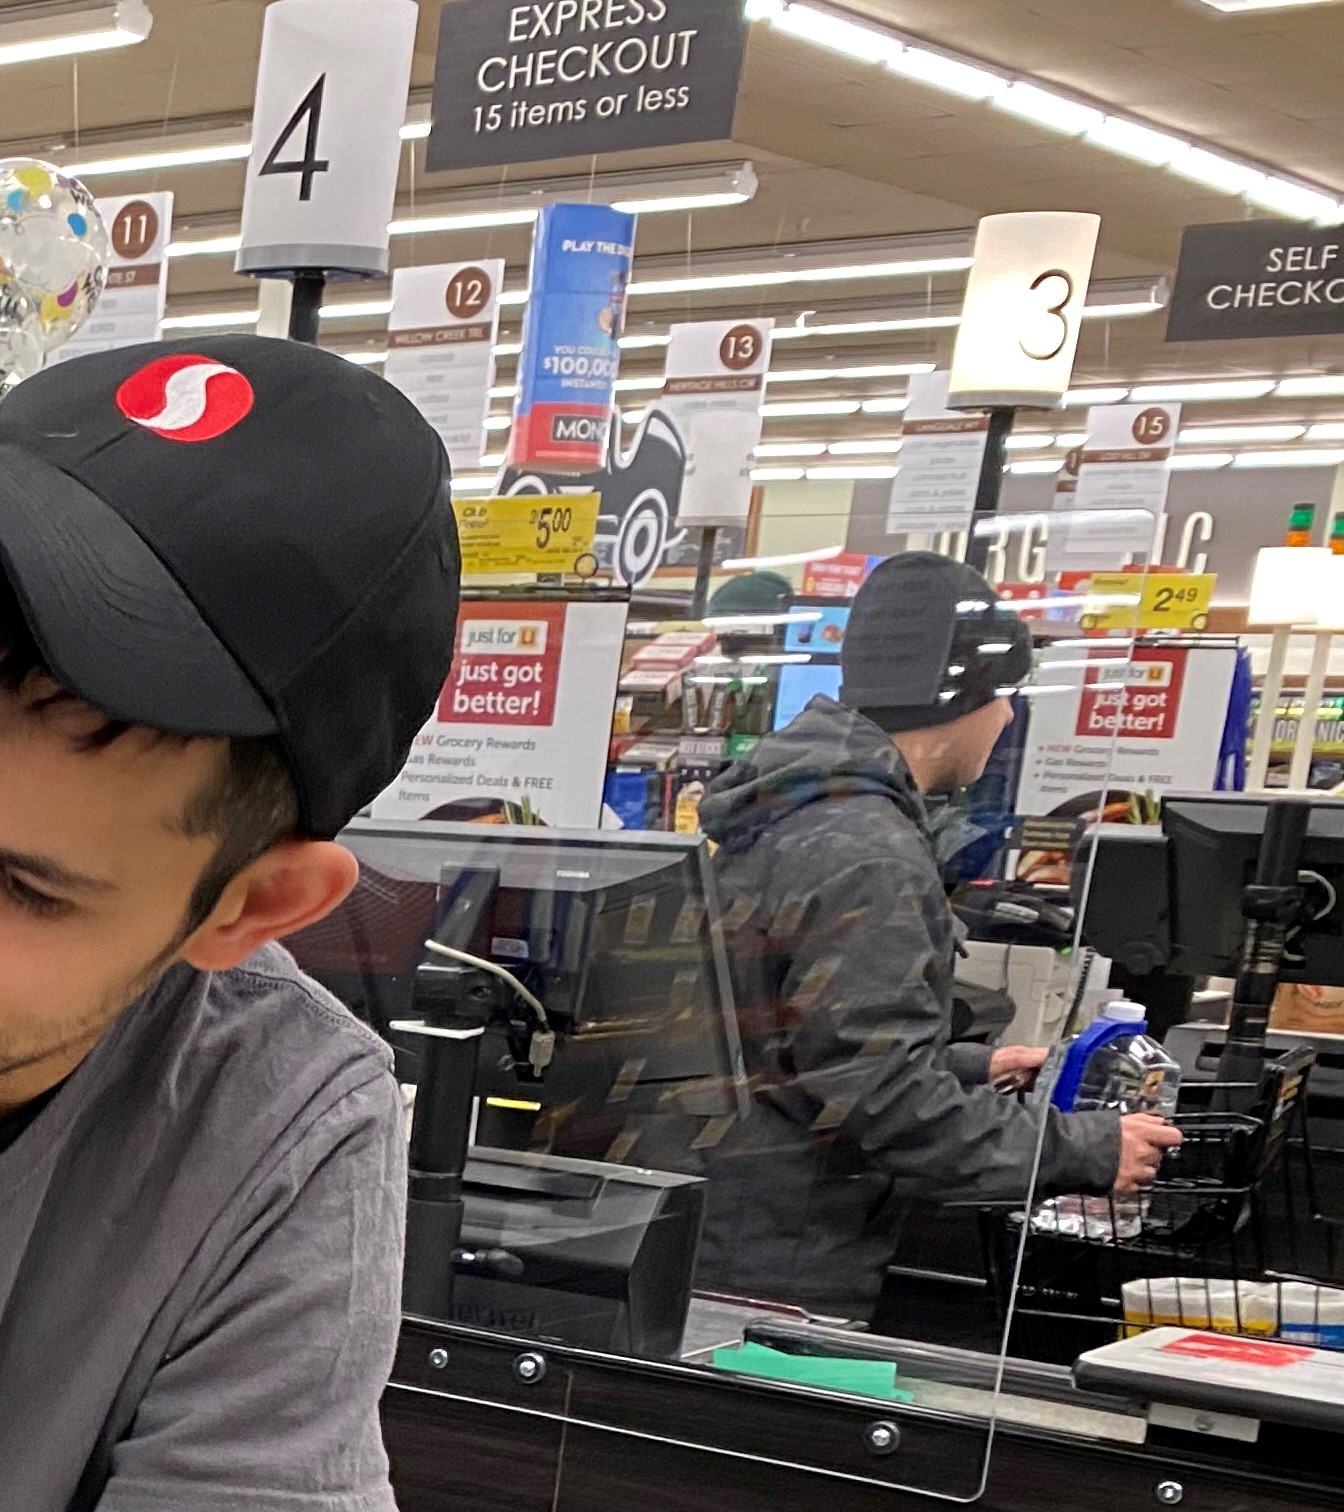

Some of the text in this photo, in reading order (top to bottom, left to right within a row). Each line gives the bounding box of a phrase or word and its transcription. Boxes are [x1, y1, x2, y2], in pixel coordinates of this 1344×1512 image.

[509, 0, 667, 43] EXPRESS
[477, 30, 698, 93] CHECKOUT
[473, 85, 690, 132] 15 items or less
[258, 73, 329, 201] 4
[122, 216, 147, 244] 11
[563, 240, 595, 253] PLAY
[1266, 245, 1339, 272] SELF
[455, 280, 482, 307] 12
[1019, 269, 1074, 361] 3
[728, 336, 753, 358] 13
[1140, 417, 1163, 435] 15
[1153, 588, 1198, 612] 249
[467, 628, 493, 646] just
[497, 628, 516, 644] for
[457, 659, 543, 688] just got
[453, 689, 540, 716] better!
[1134, 692, 1168, 710] got
[1089, 712, 1165, 731] better!
[413, 735, 536, 751] EW Grocery Rewards
[428, 754, 475, 767] Rewards
[401, 771, 553, 789] Personalized Deals & FREE
[399, 790, 430, 802] Items
